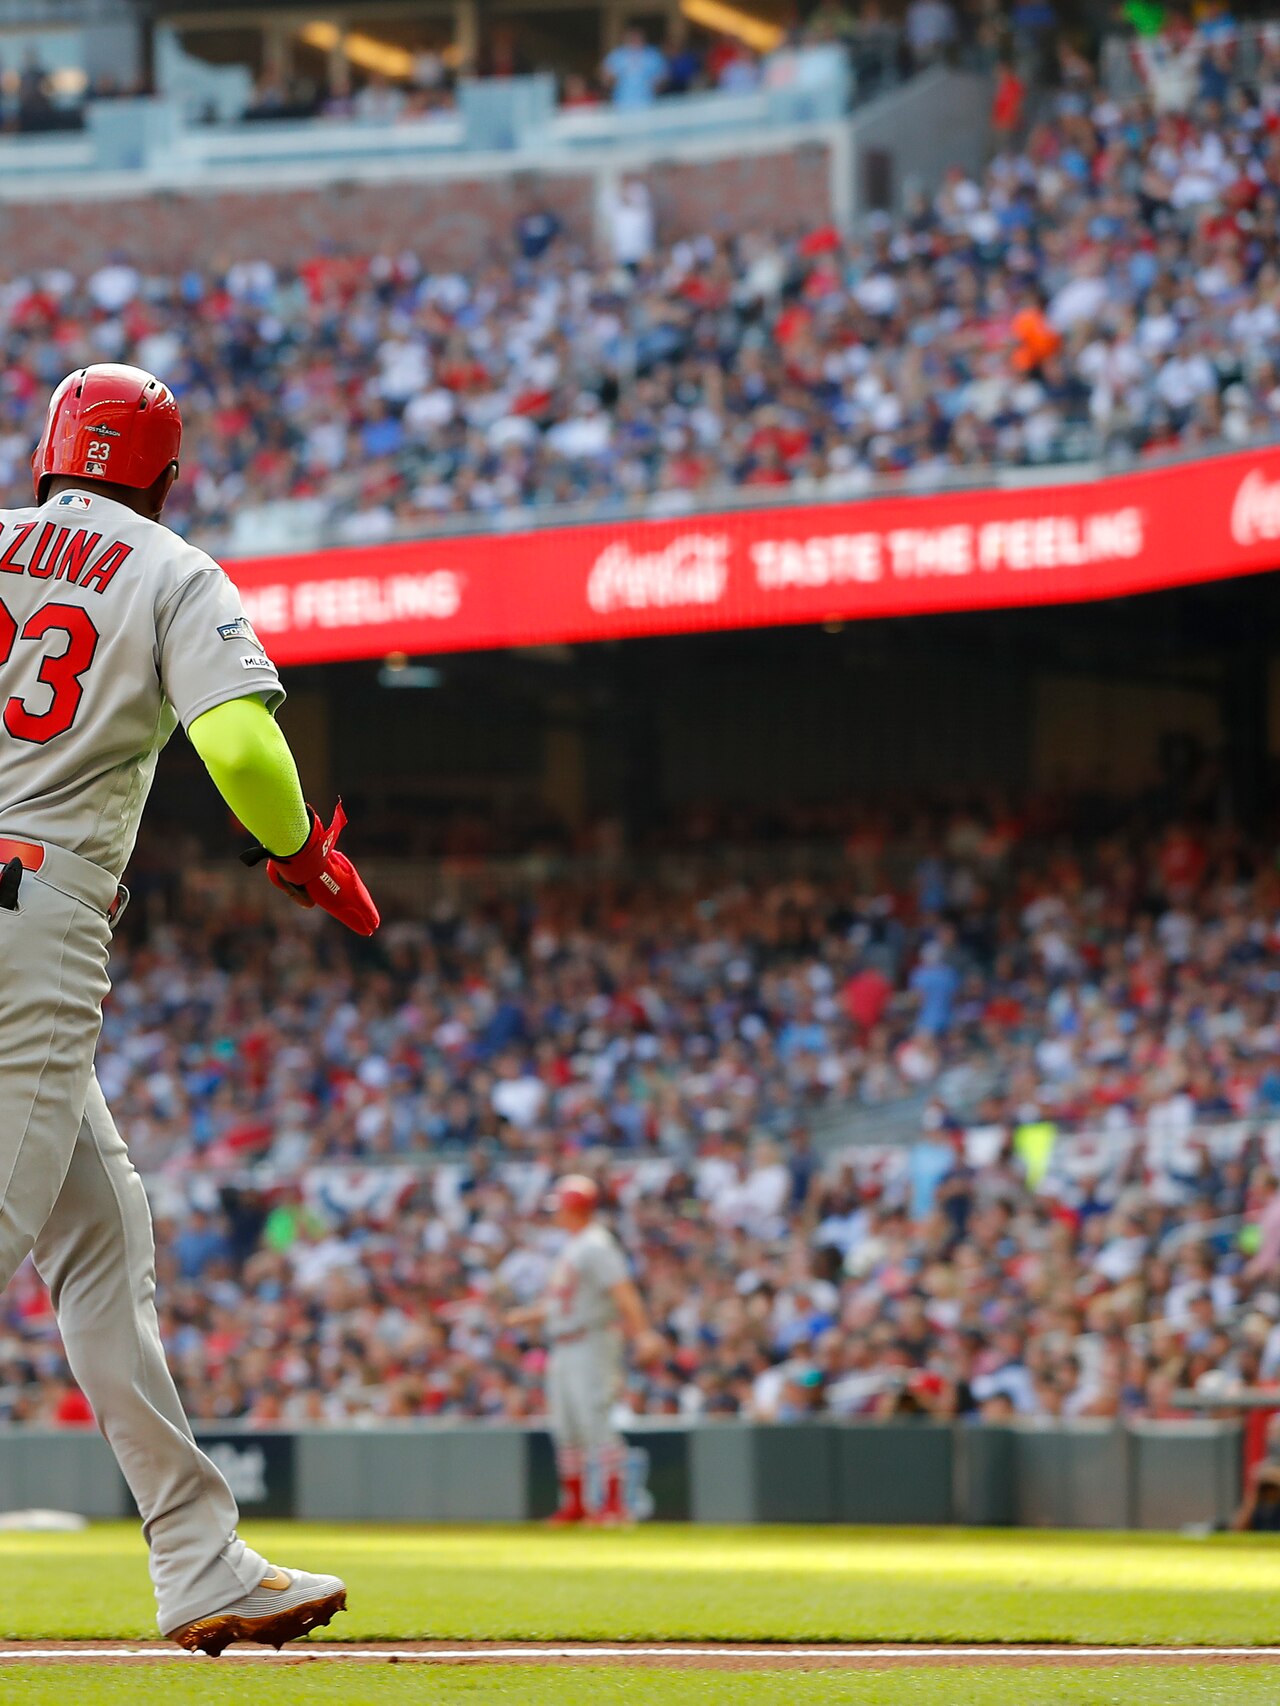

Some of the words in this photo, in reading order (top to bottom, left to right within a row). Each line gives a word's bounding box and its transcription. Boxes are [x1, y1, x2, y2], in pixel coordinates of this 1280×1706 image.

[87, 440, 111, 460] 23
[751, 532, 883, 591] TASTE
[886, 523, 973, 578] THE
[978, 507, 1143, 571] FEELING
[293, 570, 459, 629] FEELING
